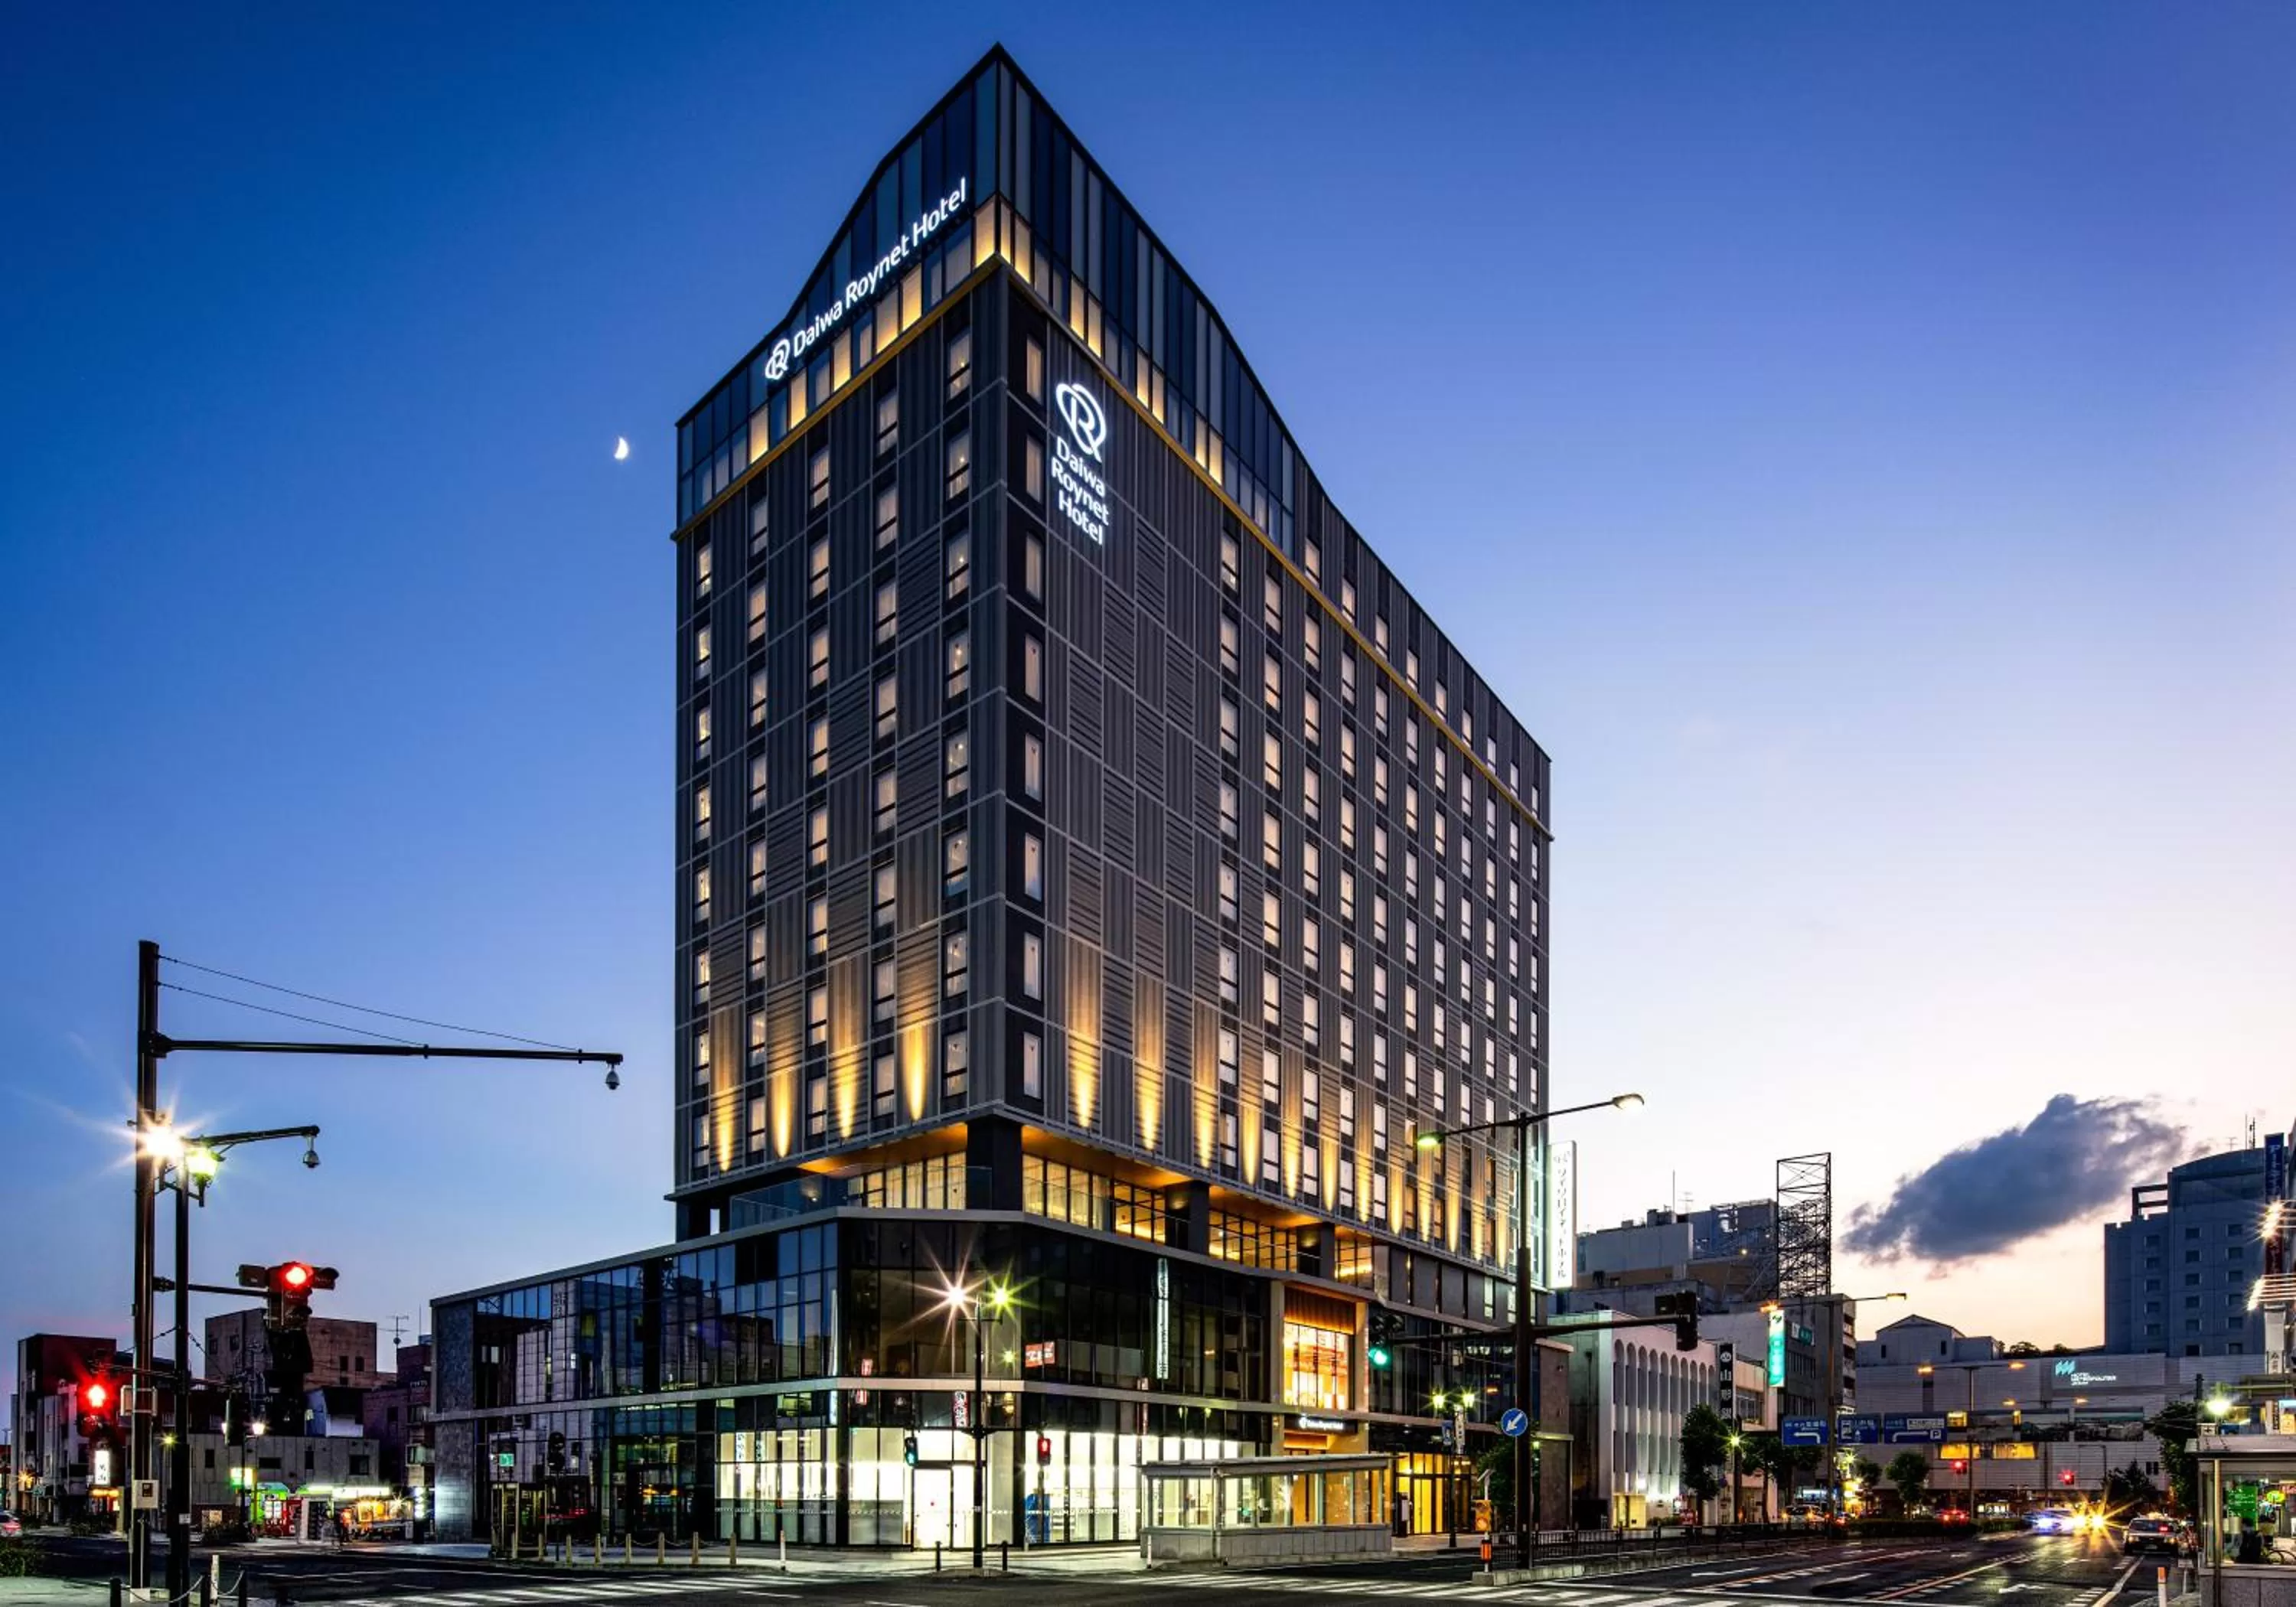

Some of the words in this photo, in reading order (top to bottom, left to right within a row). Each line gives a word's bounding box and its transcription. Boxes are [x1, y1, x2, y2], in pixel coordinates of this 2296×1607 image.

[794, 301, 843, 357] Daiwa
[846, 235, 910, 308] Roynet
[913, 177, 966, 247] Hotel
[1052, 457, 1109, 526] Roynet
[1057, 435, 1105, 497] Daiwa
[1058, 489, 1103, 545] Hotel
